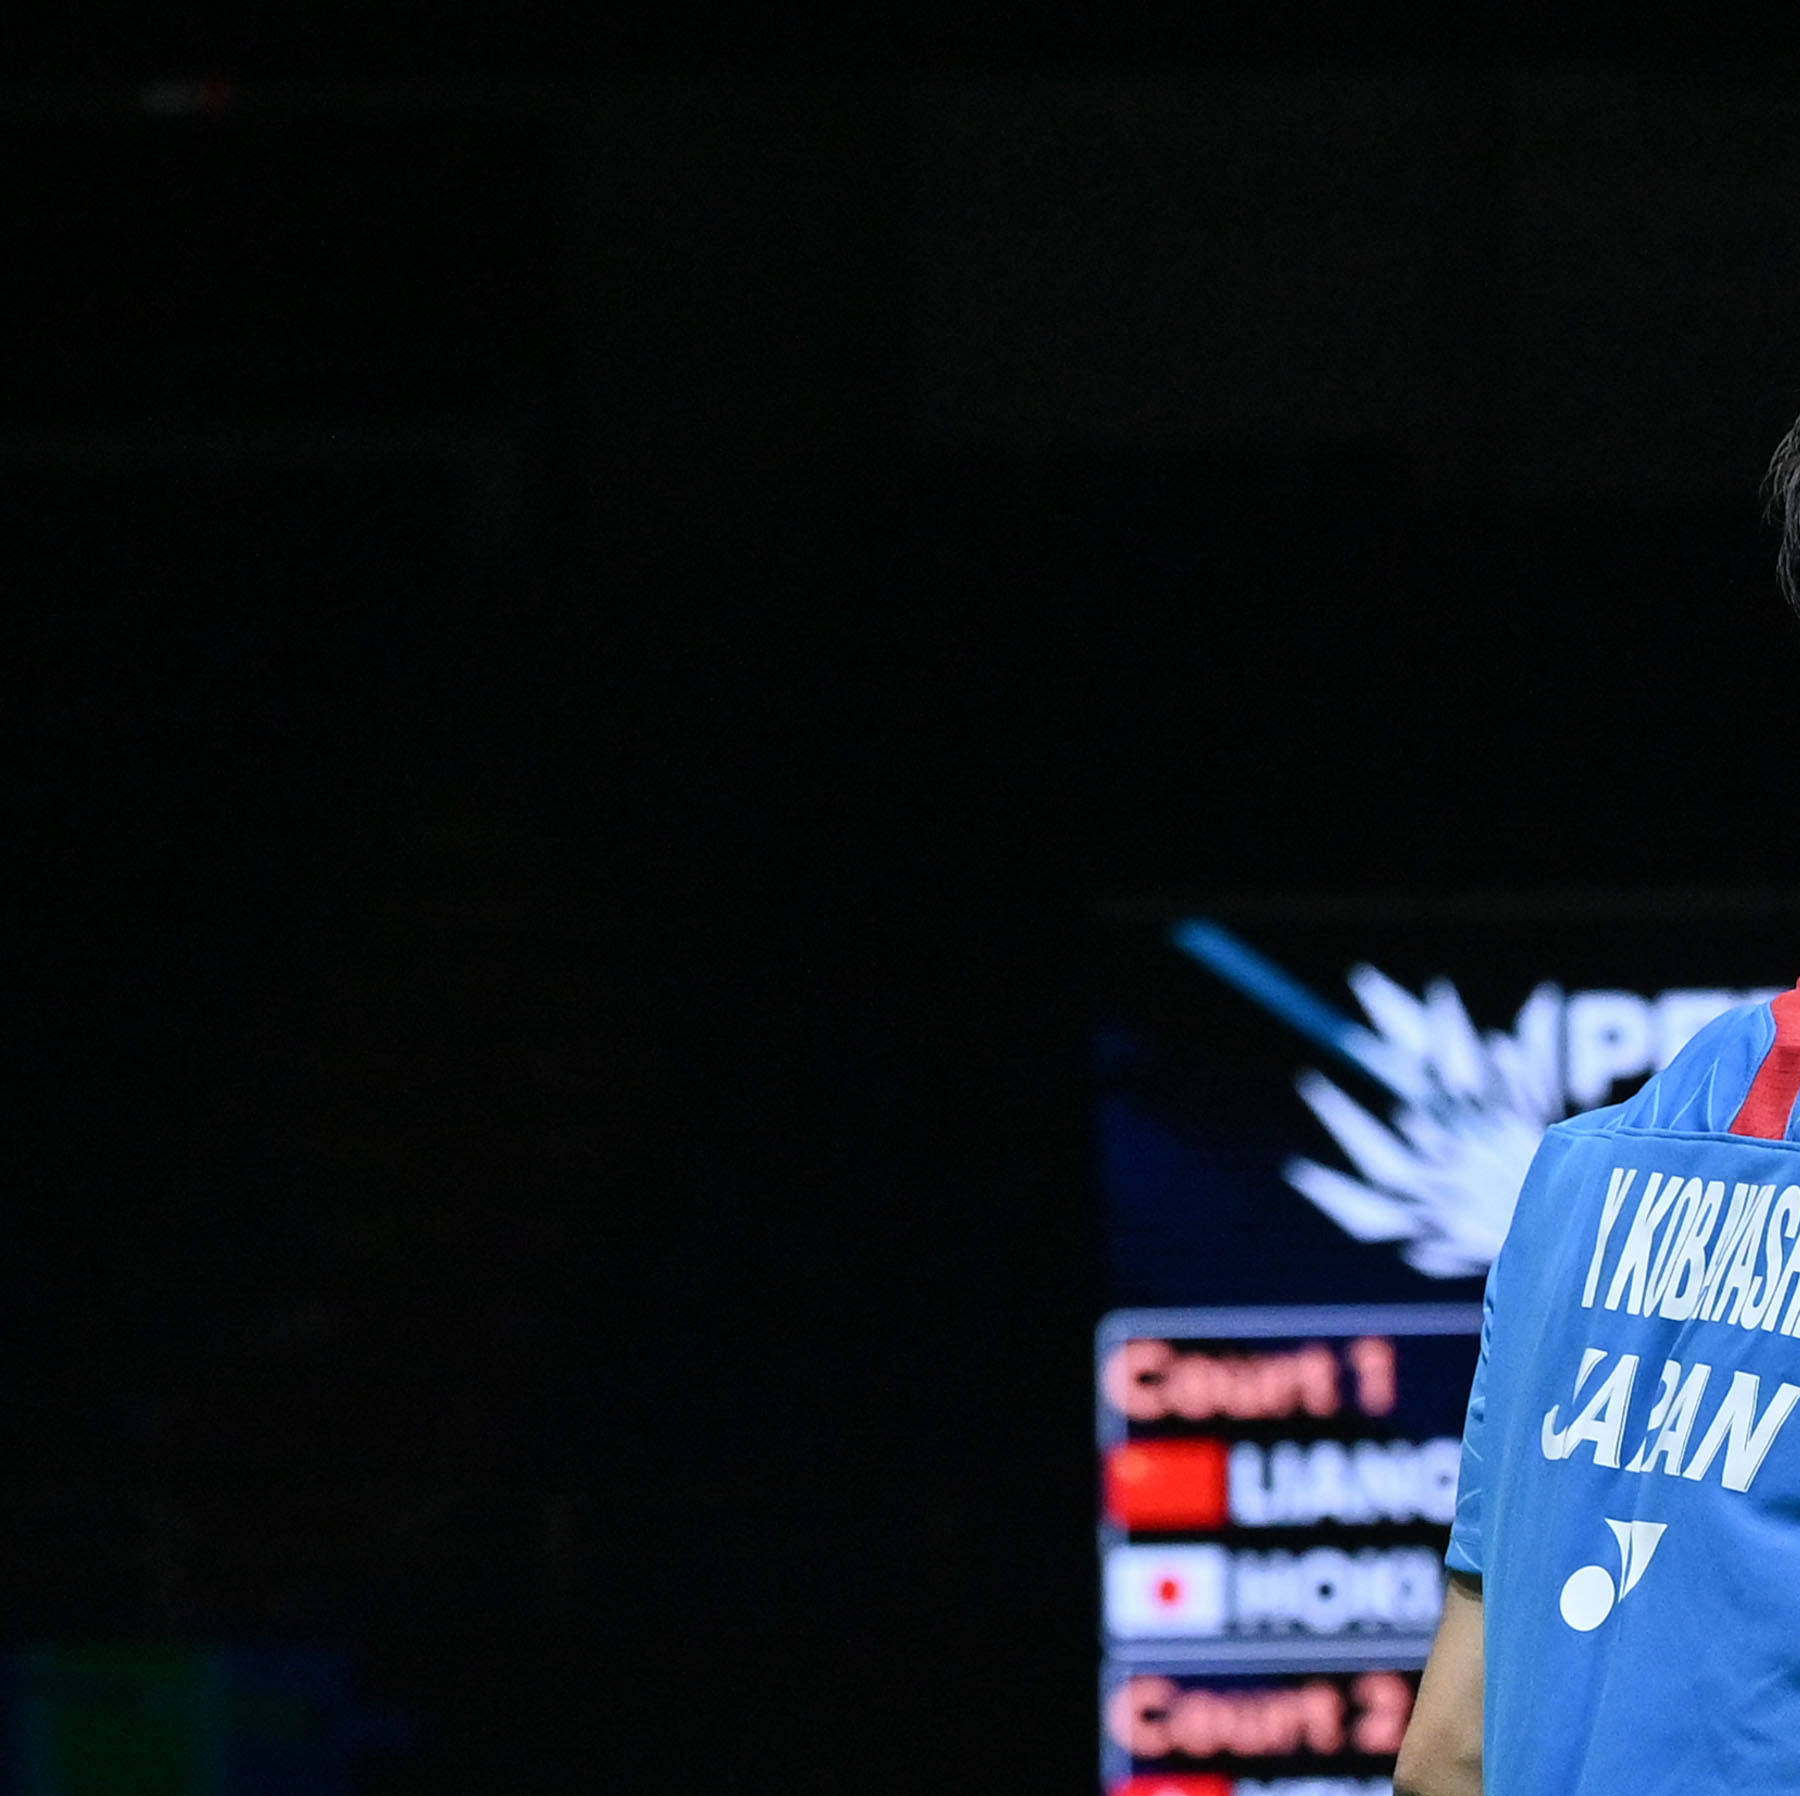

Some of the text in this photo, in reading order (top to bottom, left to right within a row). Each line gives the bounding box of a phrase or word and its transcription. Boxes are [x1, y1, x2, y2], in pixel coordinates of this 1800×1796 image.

[1581, 1167, 1638, 1309] Y
[1103, 1336, 1396, 1420] Court 1
[1108, 1675, 1345, 1758] Court
